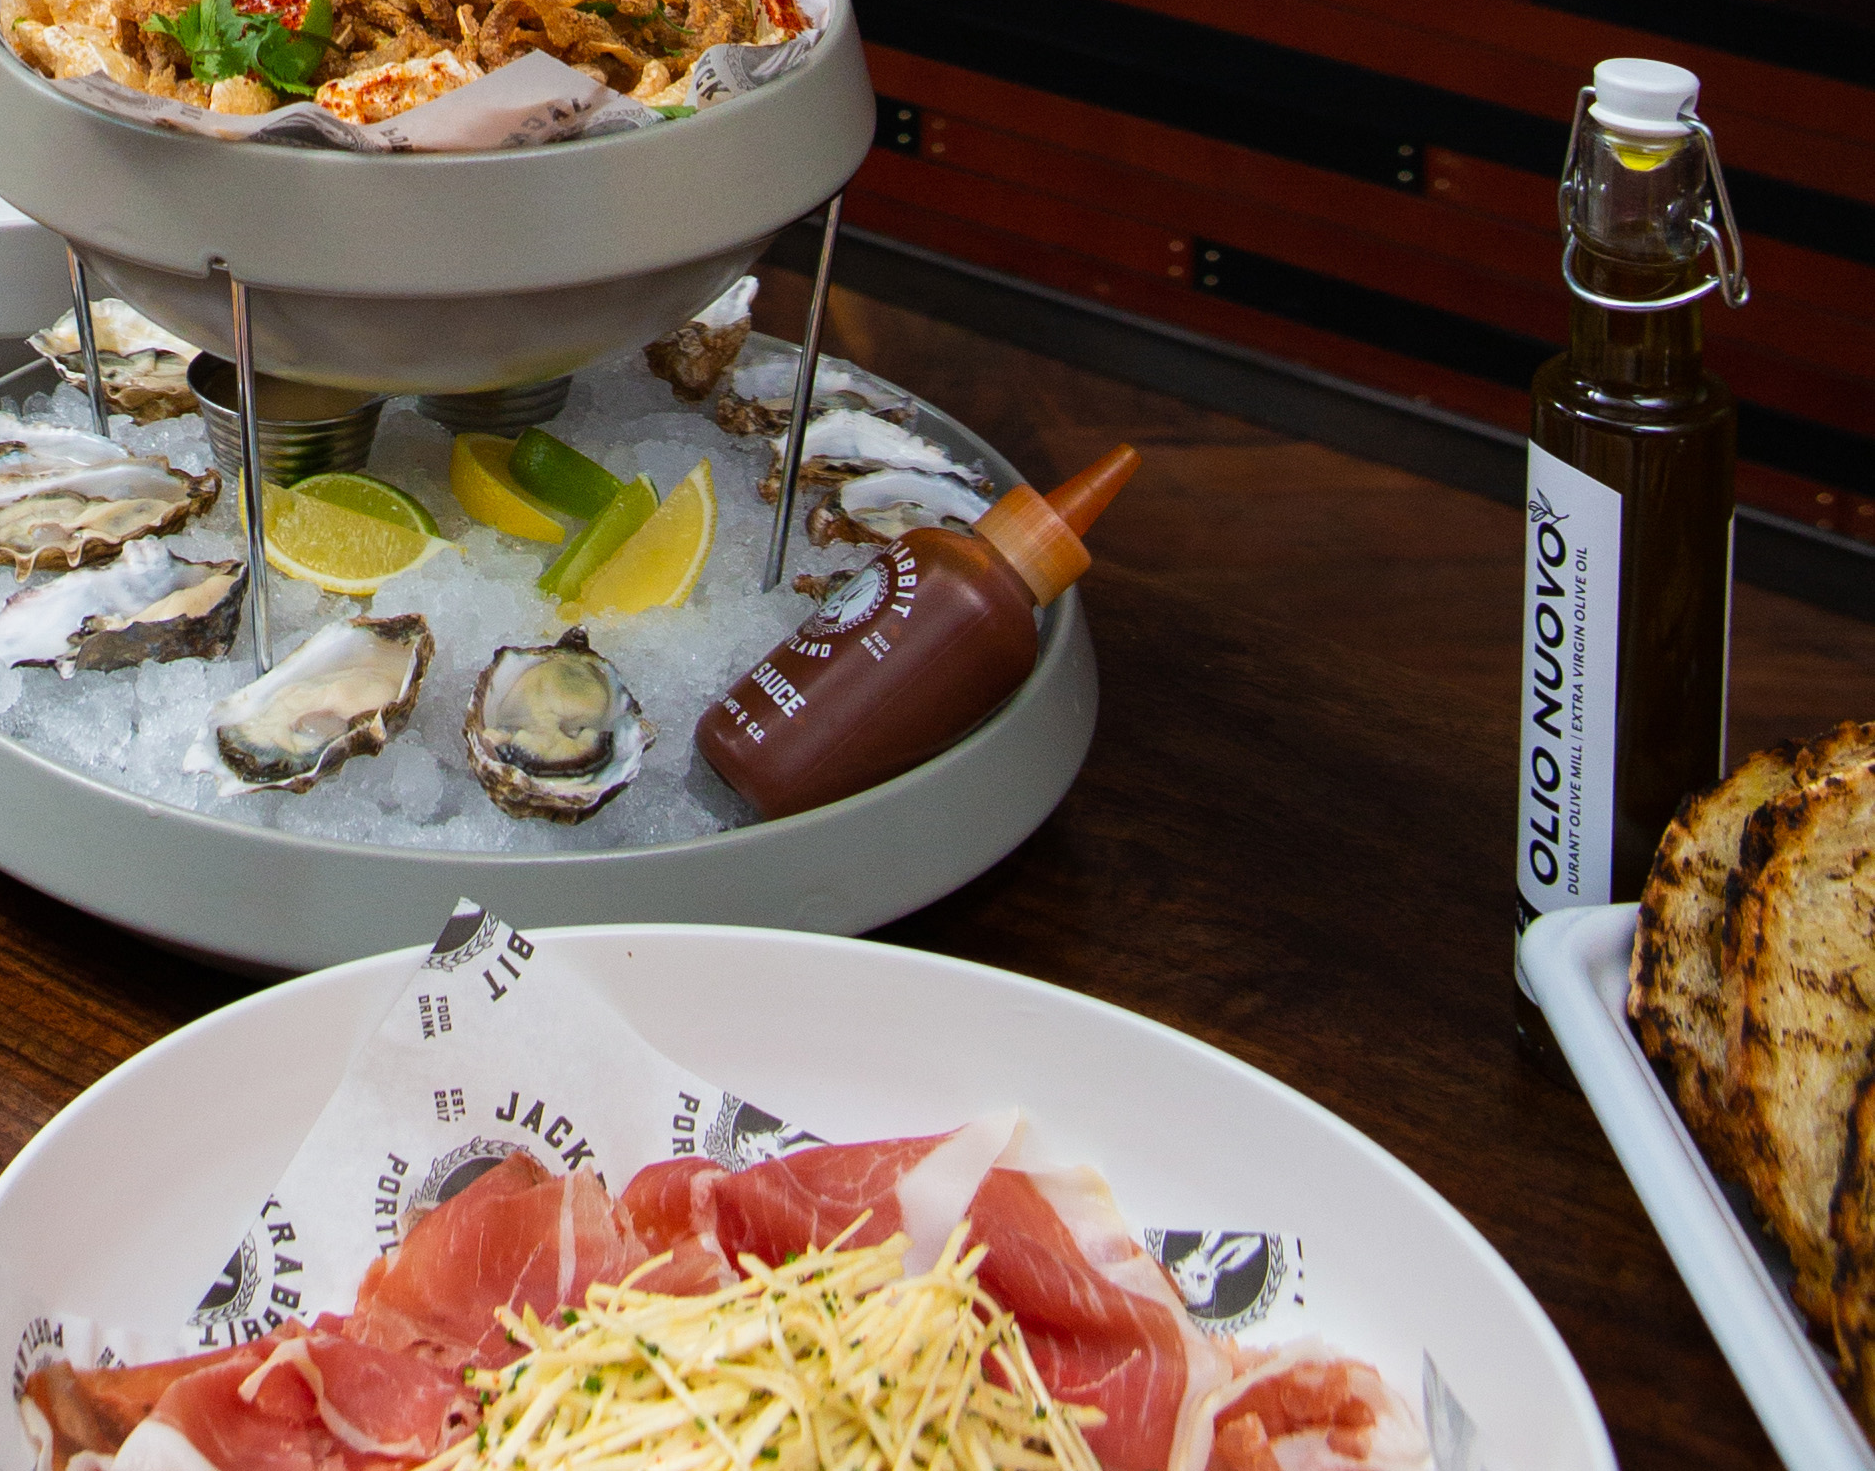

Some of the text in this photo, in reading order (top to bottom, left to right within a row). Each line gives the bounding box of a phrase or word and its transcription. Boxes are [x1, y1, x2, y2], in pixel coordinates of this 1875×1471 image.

[886, 540, 917, 619] RABBIT
[1576, 547, 1588, 572] OIL
[1574, 575, 1587, 622] OLIVE
[860, 636, 885, 663] DRINK
[870, 630, 892, 653] FOOD
[1572, 624, 1586, 678] VIRGIN
[751, 661, 807, 718] SAUCE
[1529, 521, 1567, 886] OLIO NUOVO
[1572, 683, 1584, 733] EXTRA
[1570, 744, 1583, 780] MILL
[1569, 783, 1582, 828] OLIVE
[1567, 829, 1581, 896] DURANT
[480, 930, 535, 1002] BIT
[417, 994, 436, 1040] DRINK
[435, 994, 452, 1033] FOOD
[433, 1090, 451, 1123] 2017
[450, 1087, 467, 1123] EST.
[672, 1090, 700, 1156] POR
[495, 1090, 608, 1190] JACK
